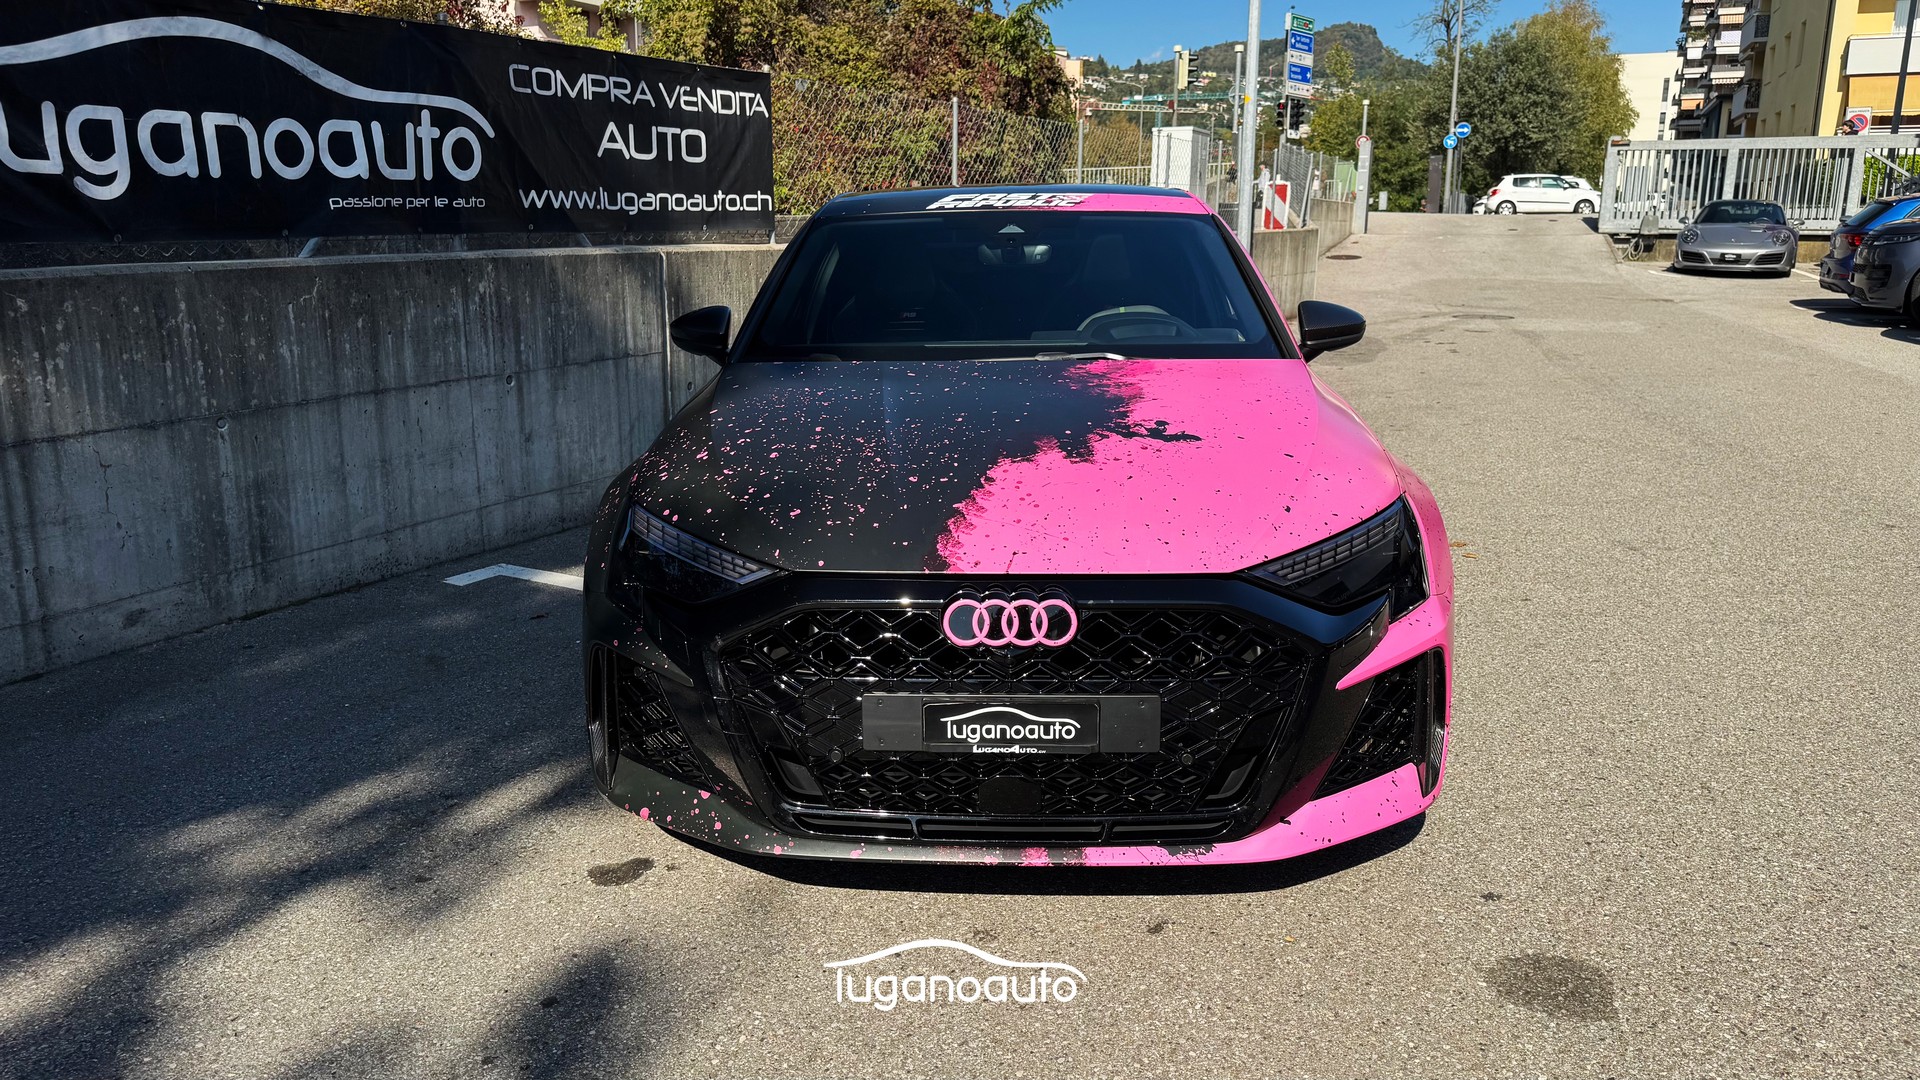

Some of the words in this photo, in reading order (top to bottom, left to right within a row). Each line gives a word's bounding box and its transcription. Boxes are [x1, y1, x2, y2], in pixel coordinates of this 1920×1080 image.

[508, 63, 656, 108] COMPRA
[658, 82, 769, 118] VENDITA
[597, 121, 707, 163] AUTO
[328, 195, 403, 210] passione
[405, 196, 431, 210] per
[434, 195, 449, 208] le
[452, 196, 486, 208] auto
[518, 186, 773, 216] www.luganoauto.ch
[926, 199, 1084, 210] REPUBLIC
[946, 720, 1077, 744] luganoauto
